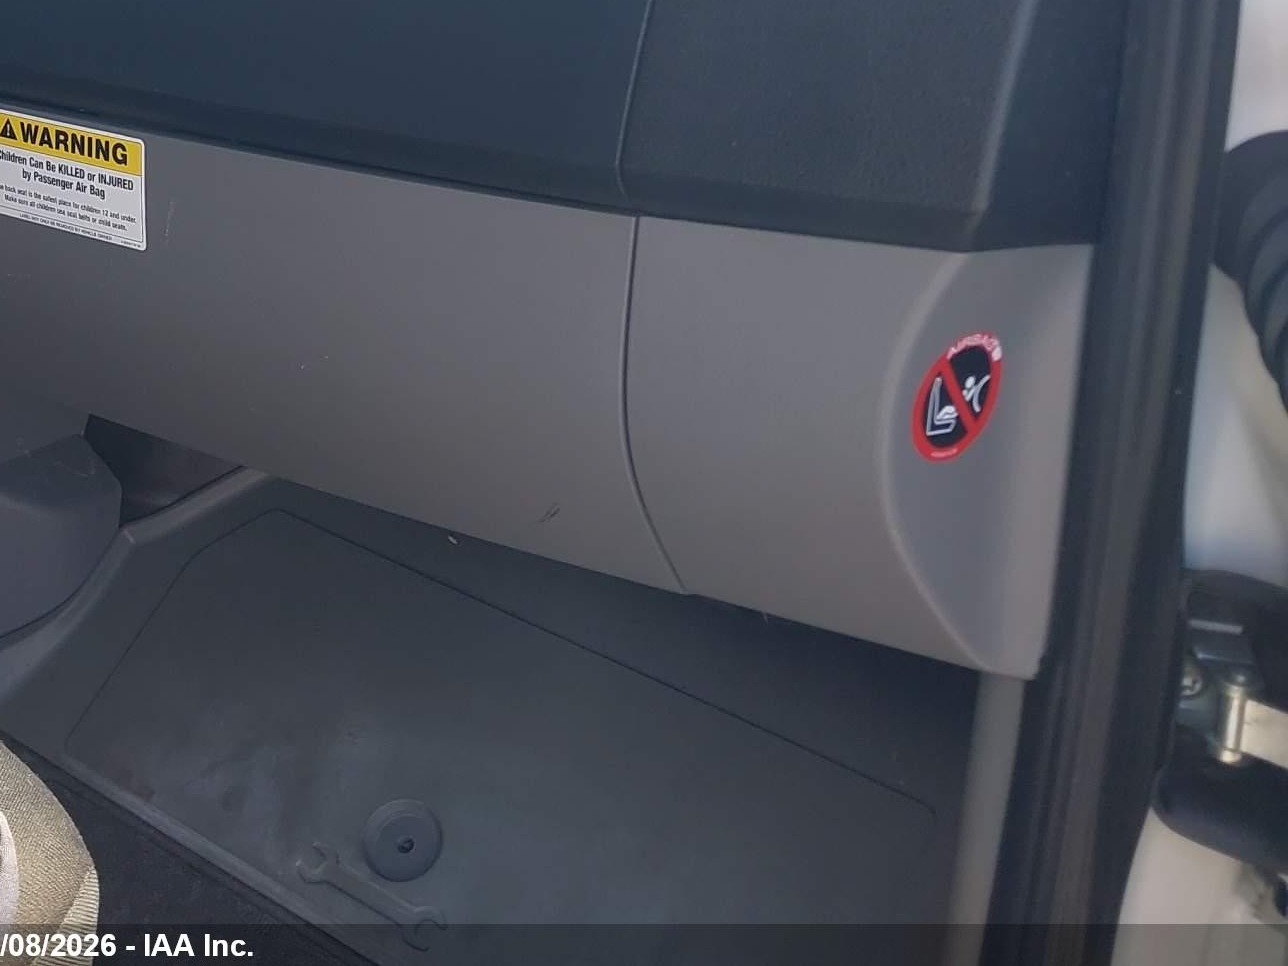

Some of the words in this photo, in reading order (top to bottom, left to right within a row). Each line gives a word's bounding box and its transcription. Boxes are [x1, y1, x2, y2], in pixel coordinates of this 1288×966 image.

[20, 121, 127, 166] WARNING
[22, 168, 32, 182] by
[33, 171, 74, 191] Passenger
[75, 181, 88, 193] Air
[89, 185, 105, 200] Bag
[29, 157, 44, 169] Can
[46, 160, 56, 173] Be
[58, 164, 85, 180] KILLED
[88, 172, 96, 182] or
[98, 173, 134, 191] INJURED
[80, 204, 101, 214] children
[110, 211, 119, 220] and
